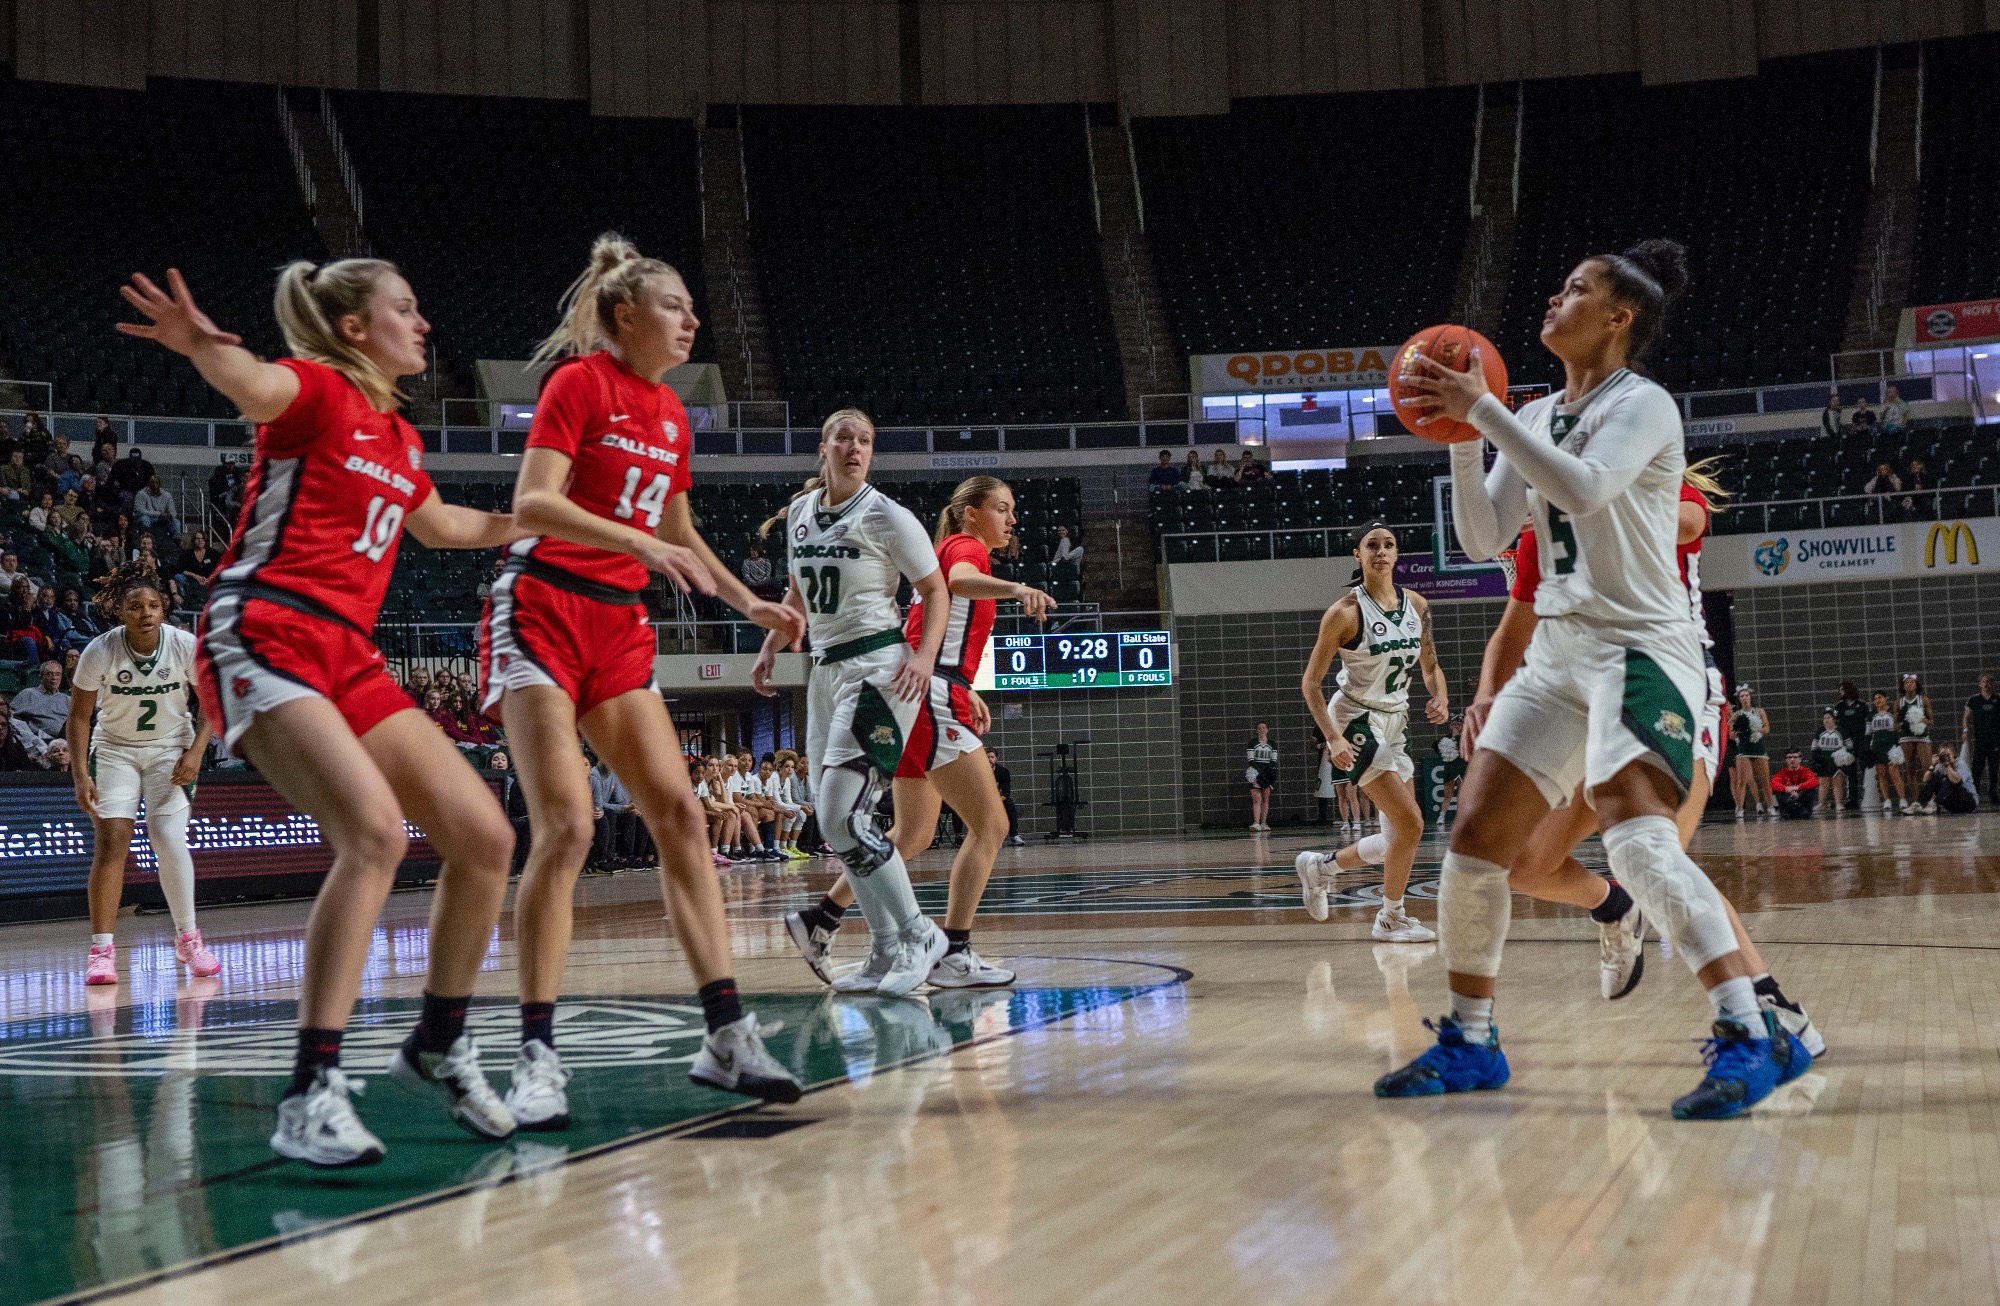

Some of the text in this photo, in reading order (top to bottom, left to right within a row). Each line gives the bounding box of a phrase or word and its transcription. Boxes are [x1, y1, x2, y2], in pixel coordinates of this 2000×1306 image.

[1226, 350, 1388, 386] QDOBA
[1263, 372, 1388, 386] MEXICAN EATS
[600, 433, 648, 457] BALL
[343, 454, 391, 485] BALL
[932, 456, 999, 467] RESERVED
[613, 465, 672, 529] 14
[351, 495, 405, 563] 10
[1547, 500, 1578, 576] 5
[1797, 536, 1897, 563] SNOWVILLE
[1409, 563, 1435, 574] Care
[1819, 557, 1877, 569] CREAMERY
[1436, 578, 1478, 588] KINDNESS
[1005, 637, 1032, 647] OHIO
[1122, 633, 1167, 643] Ball State
[1058, 639, 1109, 660] 9:28
[1138, 647, 1153, 669] 0
[705, 664, 722, 677] EXIT
[1011, 651, 1026, 672] 0
[1001, 676, 1039, 686] 0 FOULS
[1071, 667, 1098, 684] :19
[1128, 672, 1166, 683] 0 FOULS
[110, 682, 181, 696] BOBCATS
[136, 699, 158, 732] 2
[184, 814, 322, 849] OhioHealth
